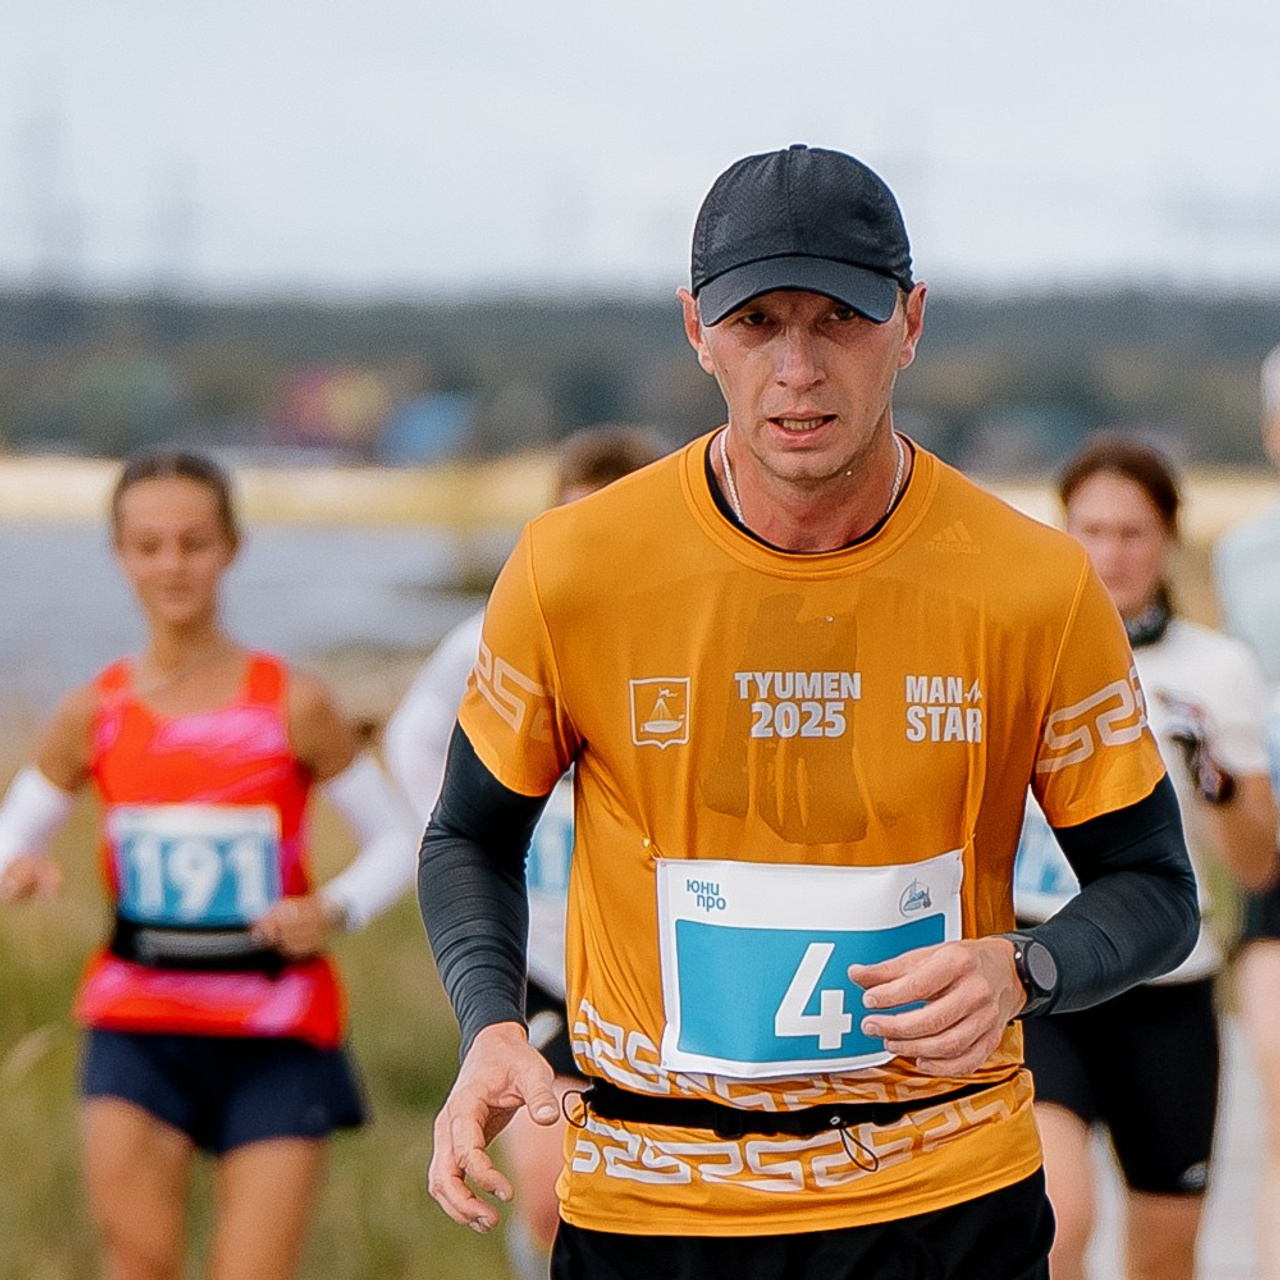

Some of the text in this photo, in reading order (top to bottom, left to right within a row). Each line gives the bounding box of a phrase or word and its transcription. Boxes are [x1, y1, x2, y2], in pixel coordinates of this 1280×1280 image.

[734, 672, 861, 700] TYUMEN
[905, 675, 963, 704] MAN
[750, 701, 847, 738] 2025
[905, 706, 983, 744] STAR
[129, 835, 269, 922] 191
[686, 879, 719, 896] юни
[697, 894, 727, 912] про
[775, 942, 852, 1050] 4
